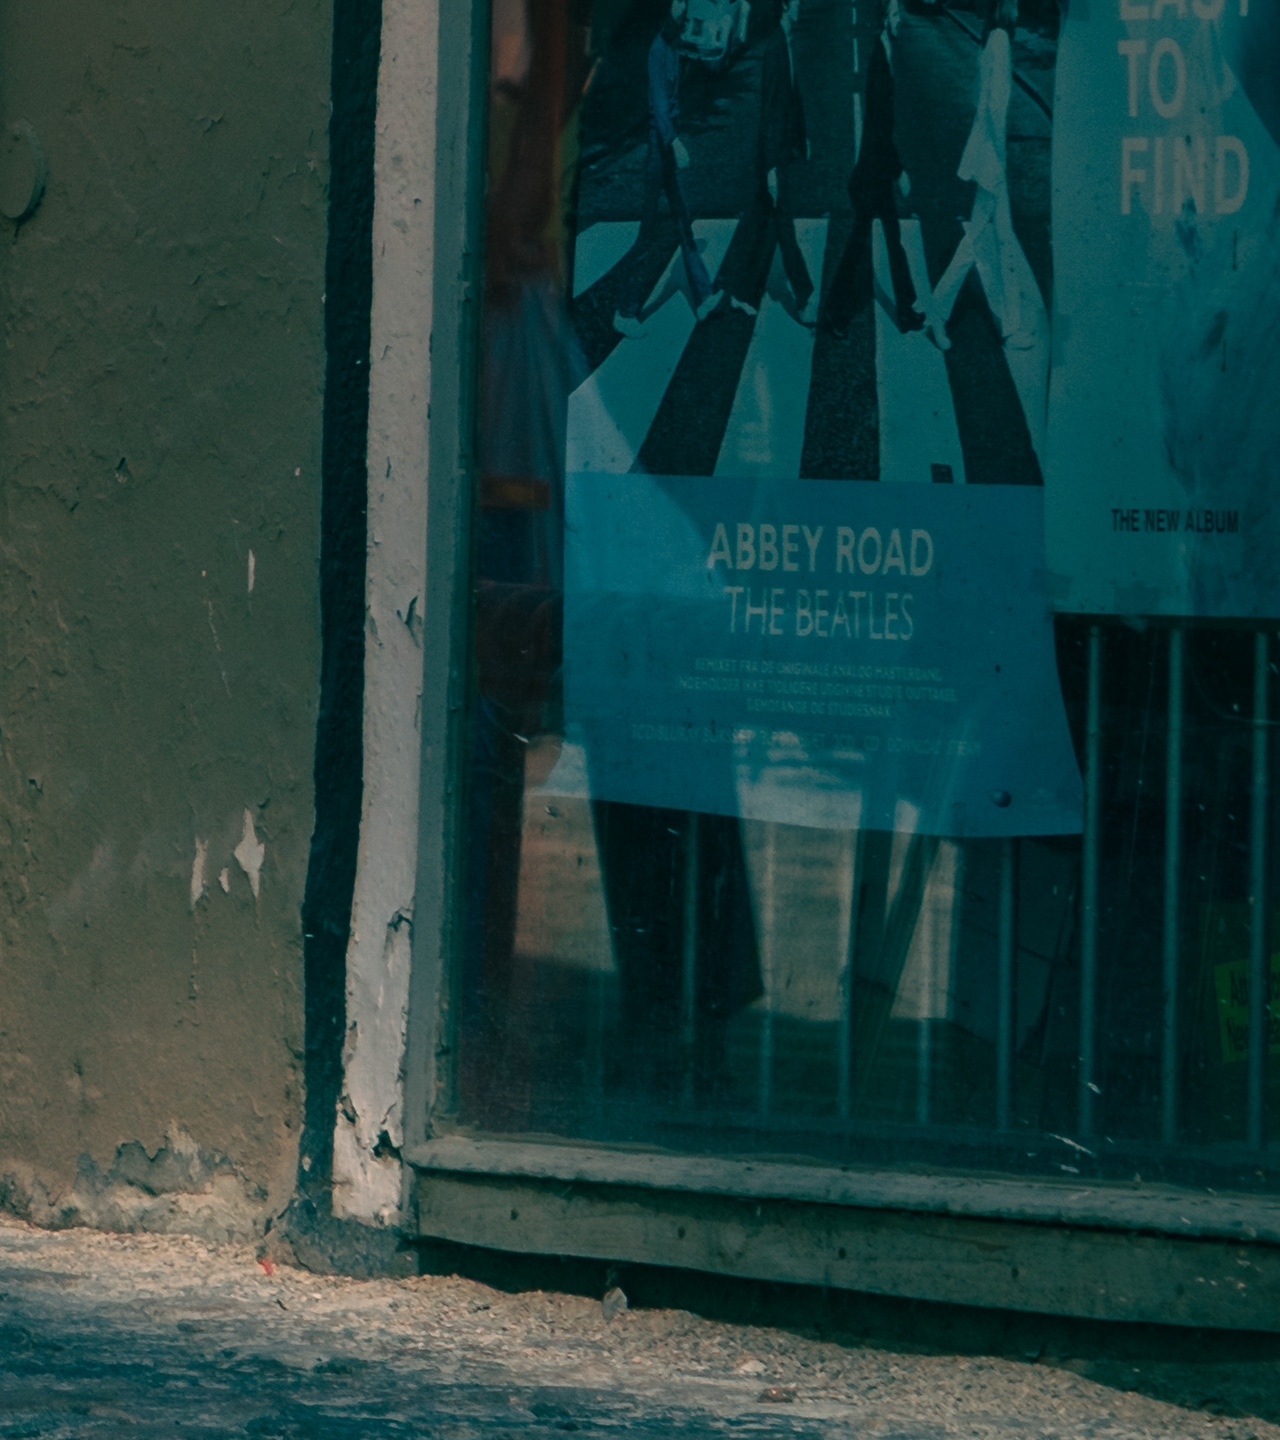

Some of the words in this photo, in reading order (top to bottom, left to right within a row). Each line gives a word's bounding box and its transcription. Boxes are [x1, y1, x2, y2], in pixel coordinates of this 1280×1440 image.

[1118, 38, 1186, 119] TO
[1118, 135, 1250, 216] FIND
[707, 522, 824, 573] ABBEY
[835, 526, 935, 577] ROAD
[1111, 507, 1141, 534] THE
[1145, 508, 1181, 534] NEW
[1184, 508, 1240, 536] ALBUM
[724, 585, 785, 636] THE
[795, 588, 915, 642] BEATLES
